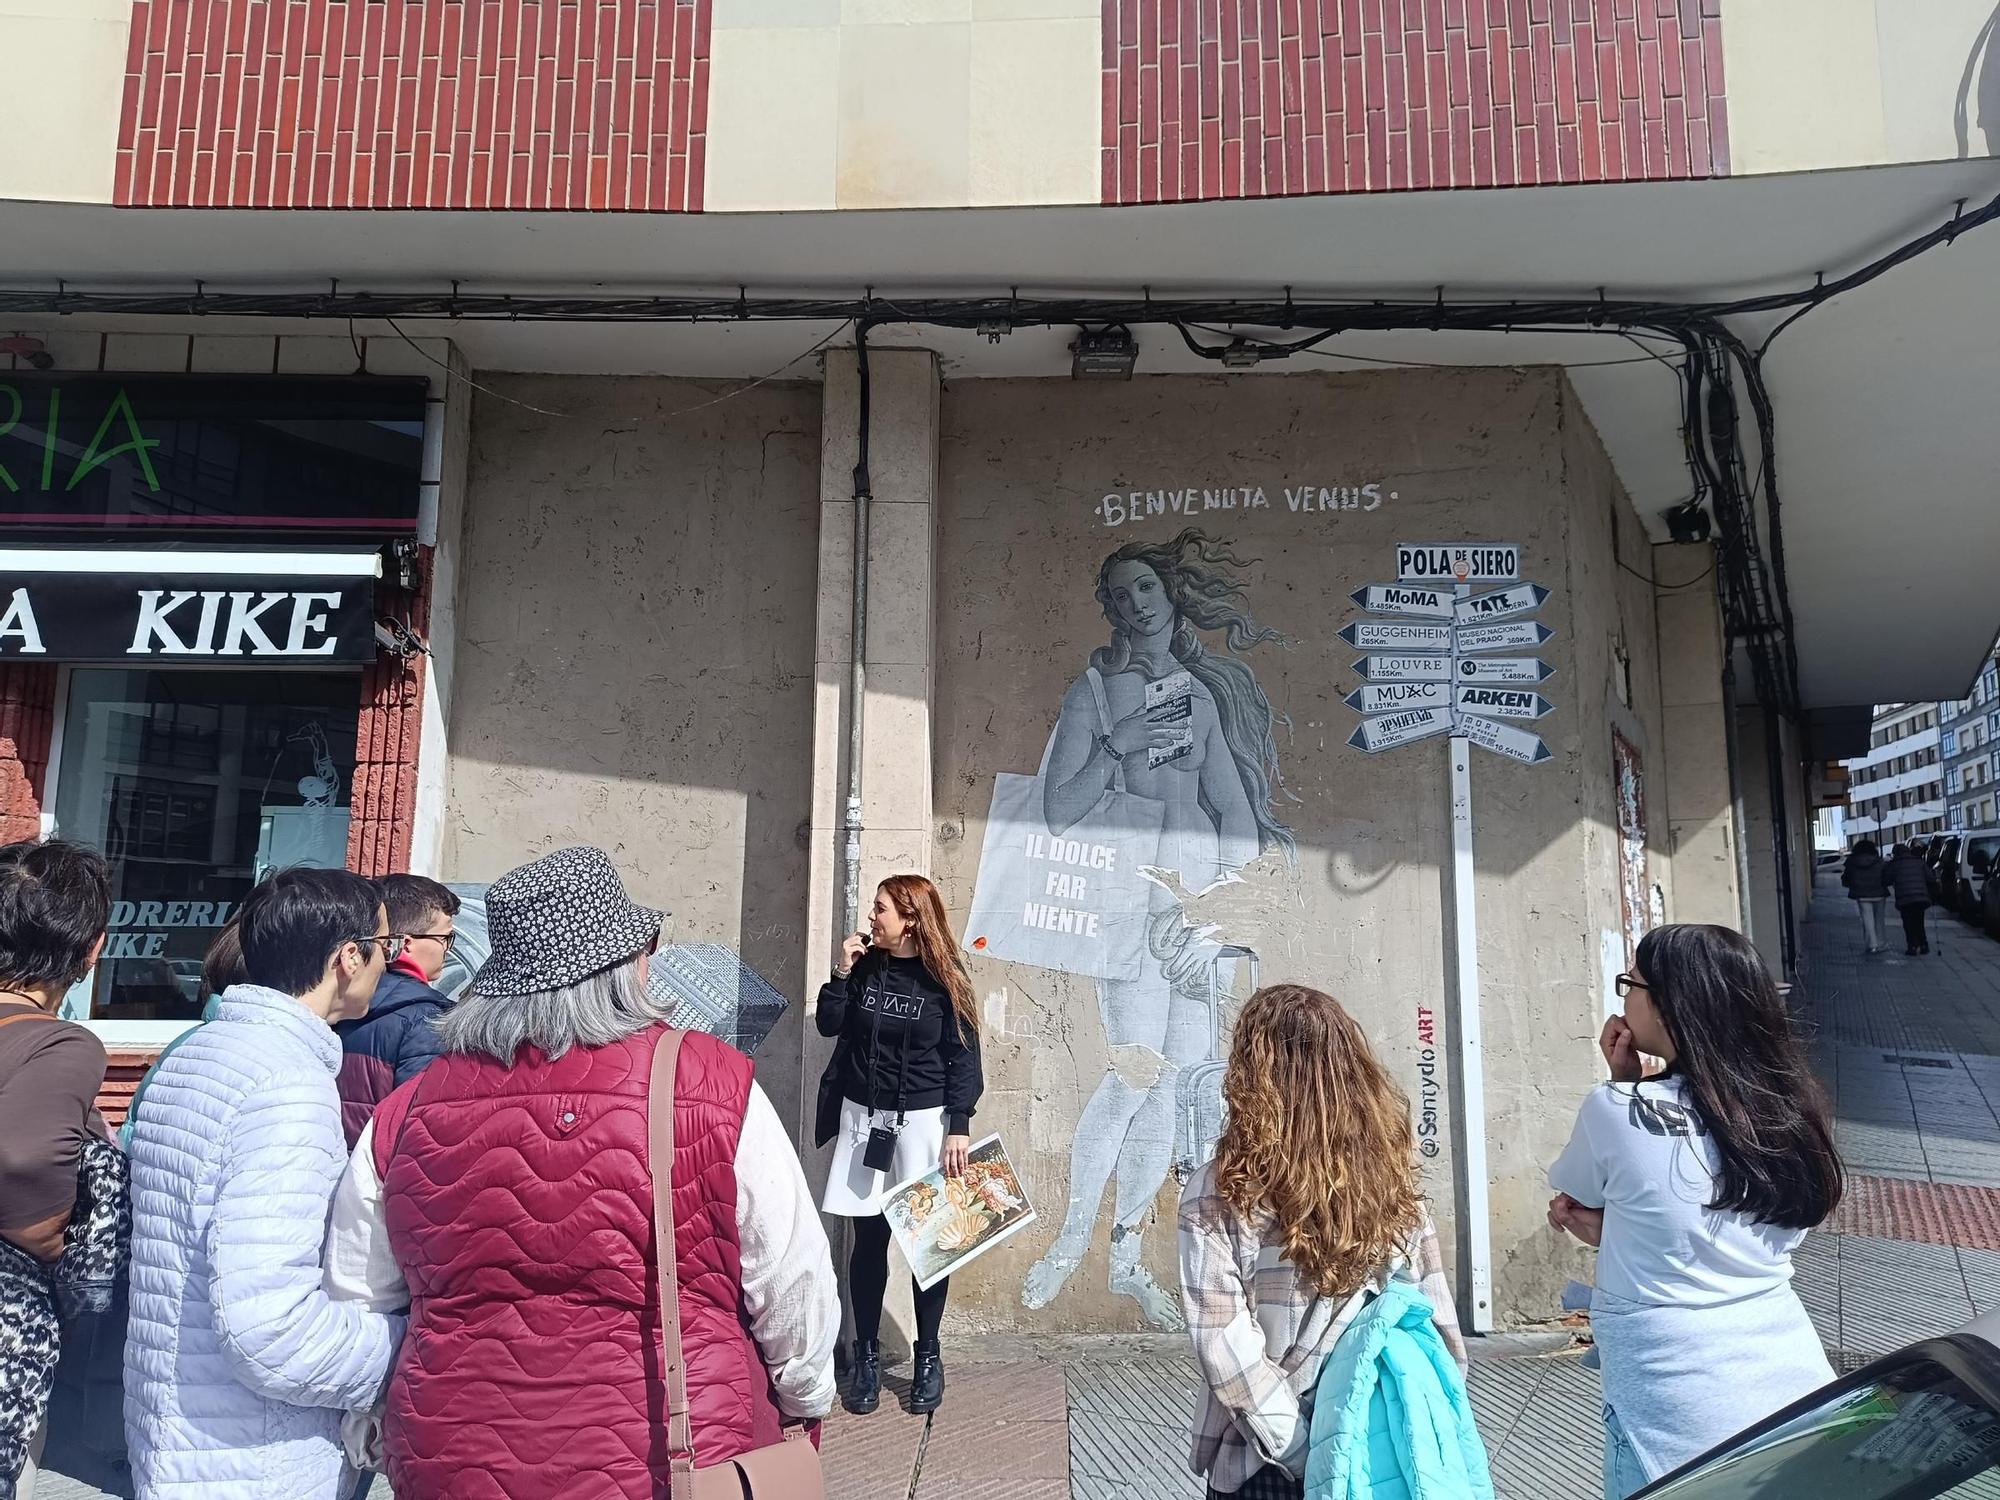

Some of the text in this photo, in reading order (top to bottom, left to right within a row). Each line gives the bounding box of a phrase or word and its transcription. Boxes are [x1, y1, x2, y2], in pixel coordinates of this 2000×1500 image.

[1400, 550, 1515, 576] POLA DE SIERO
[1385, 589, 1438, 607] MoMA
[1470, 593, 1511, 612] TATE
[1497, 600, 1528, 613] MODERN
[126, 590, 342, 655] KIKE
[1361, 626, 1449, 639] GUGGENHEIM
[1459, 625, 1525, 638] MUSEO NACIONAL
[1476, 635, 1503, 644] PRADO
[1461, 690, 1532, 708] ARKEN
[1025, 834, 1117, 872] IL DOLCE
[1045, 871, 1087, 901] FAR
[107, 901, 240, 926] DRERI
[1022, 902, 1099, 938] NIENTE
[99, 933, 168, 958] IKE
